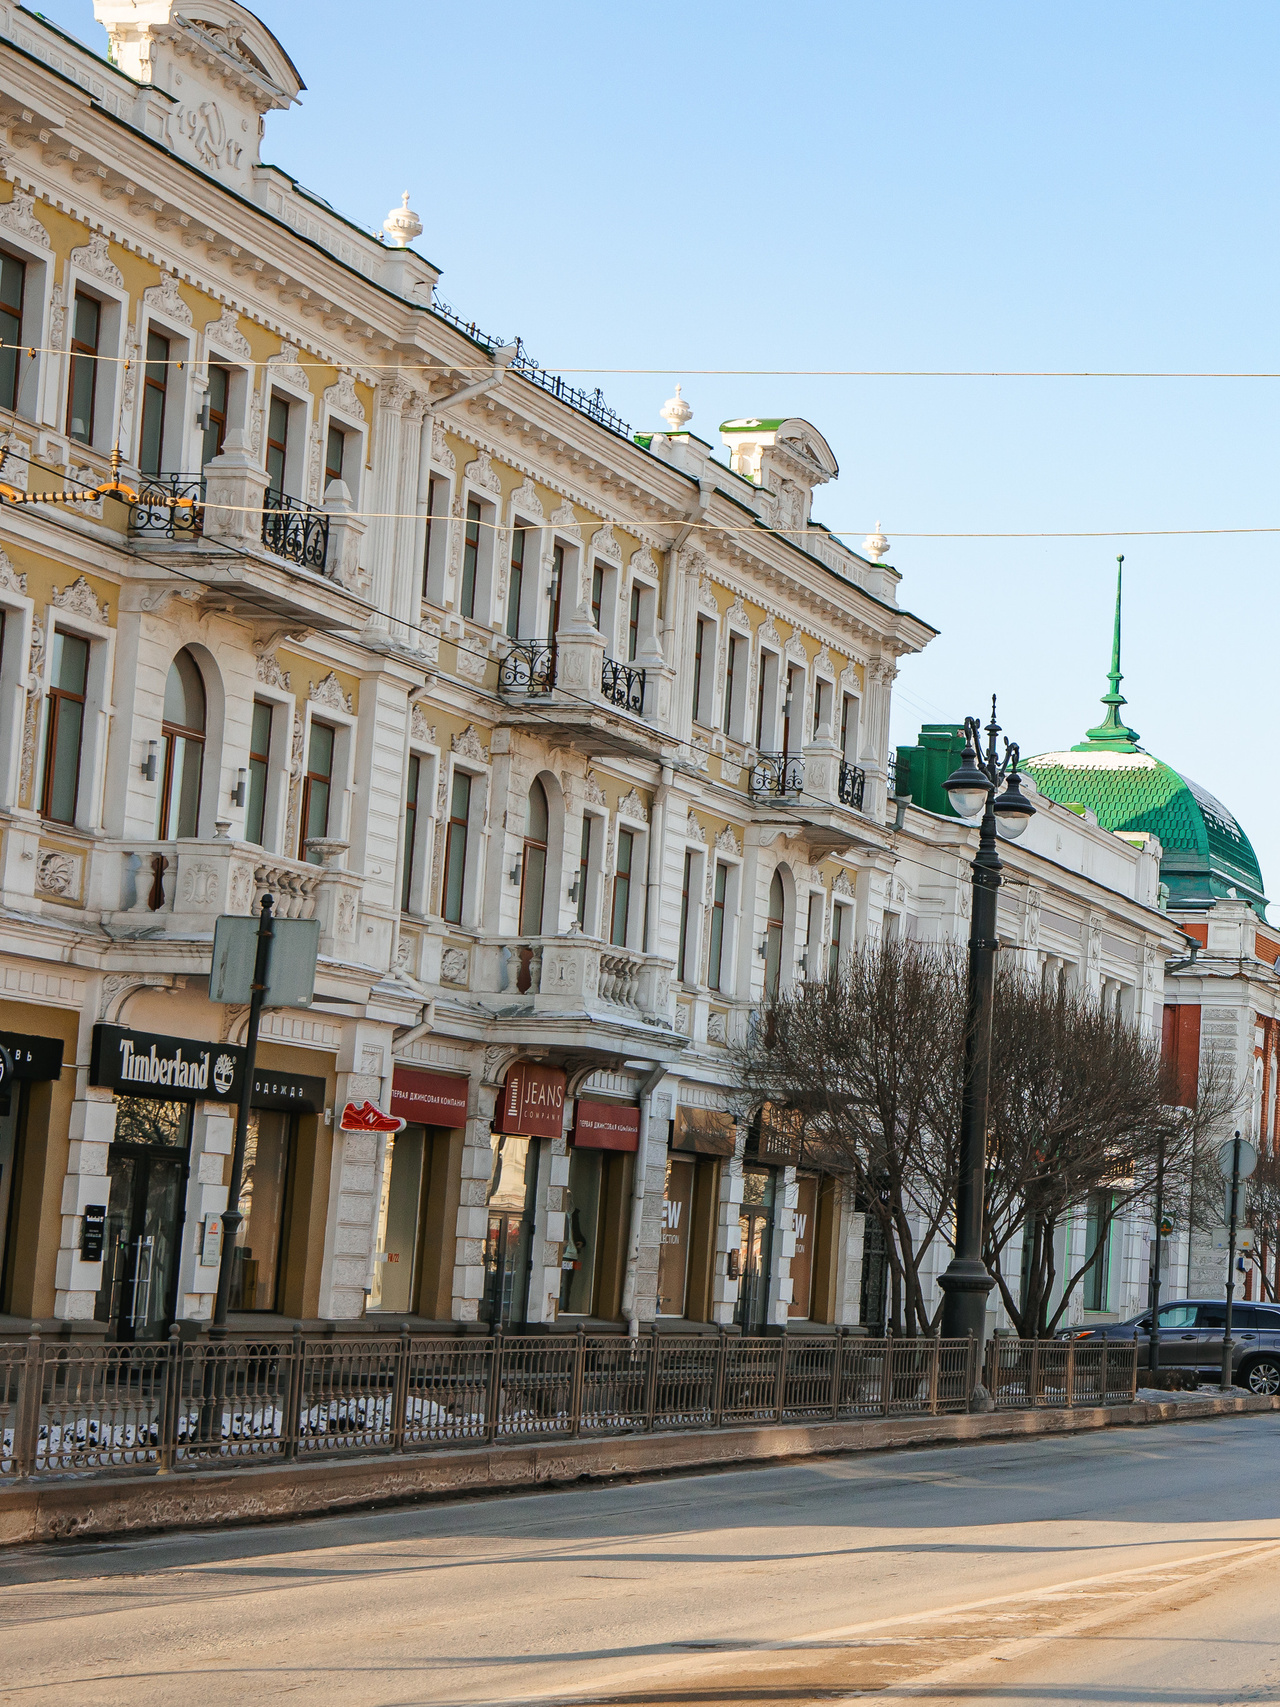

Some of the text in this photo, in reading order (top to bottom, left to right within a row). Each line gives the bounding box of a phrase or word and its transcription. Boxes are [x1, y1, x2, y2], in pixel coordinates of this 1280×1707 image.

[119, 1038, 210, 1090] Timberland
[255, 1081, 304, 1098] одежда
[524, 1081, 563, 1108] JEANS
[409, 1092, 440, 1104] ДЖИНСОВАЯ
[440, 1096, 466, 1108] КОМПАНИЯ
[523, 1110, 561, 1121] COMPANY
